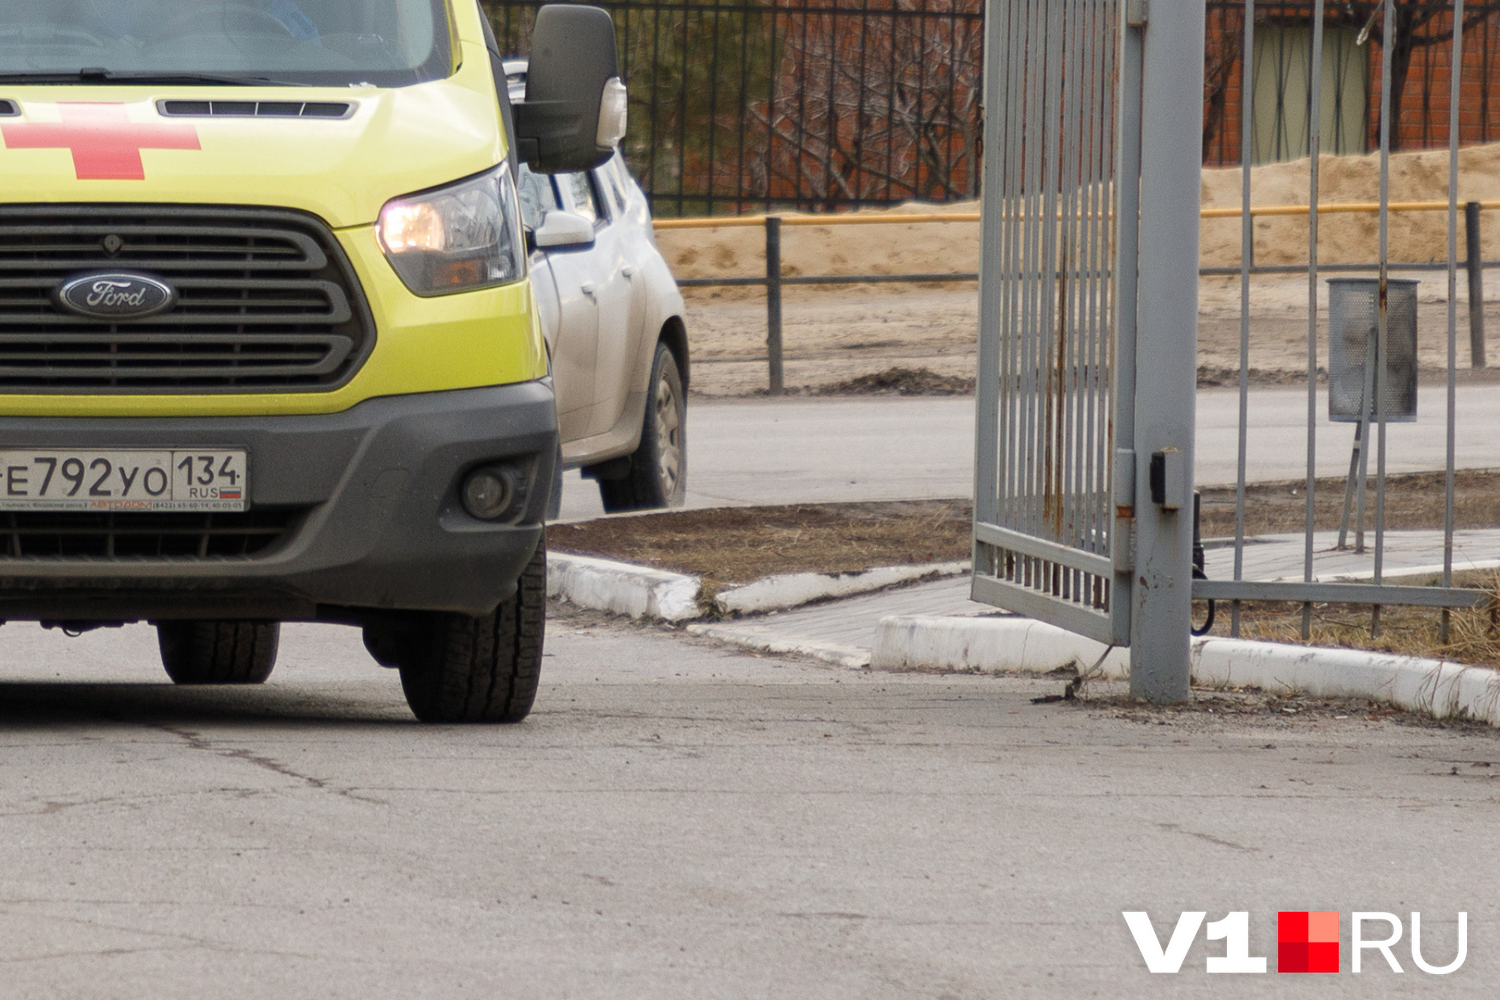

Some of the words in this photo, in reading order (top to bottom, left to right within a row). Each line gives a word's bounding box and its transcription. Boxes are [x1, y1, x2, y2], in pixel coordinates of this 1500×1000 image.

[86, 281, 147, 306] Ford
[177, 456, 238, 486] 134
[189, 487, 218, 499] RUS
